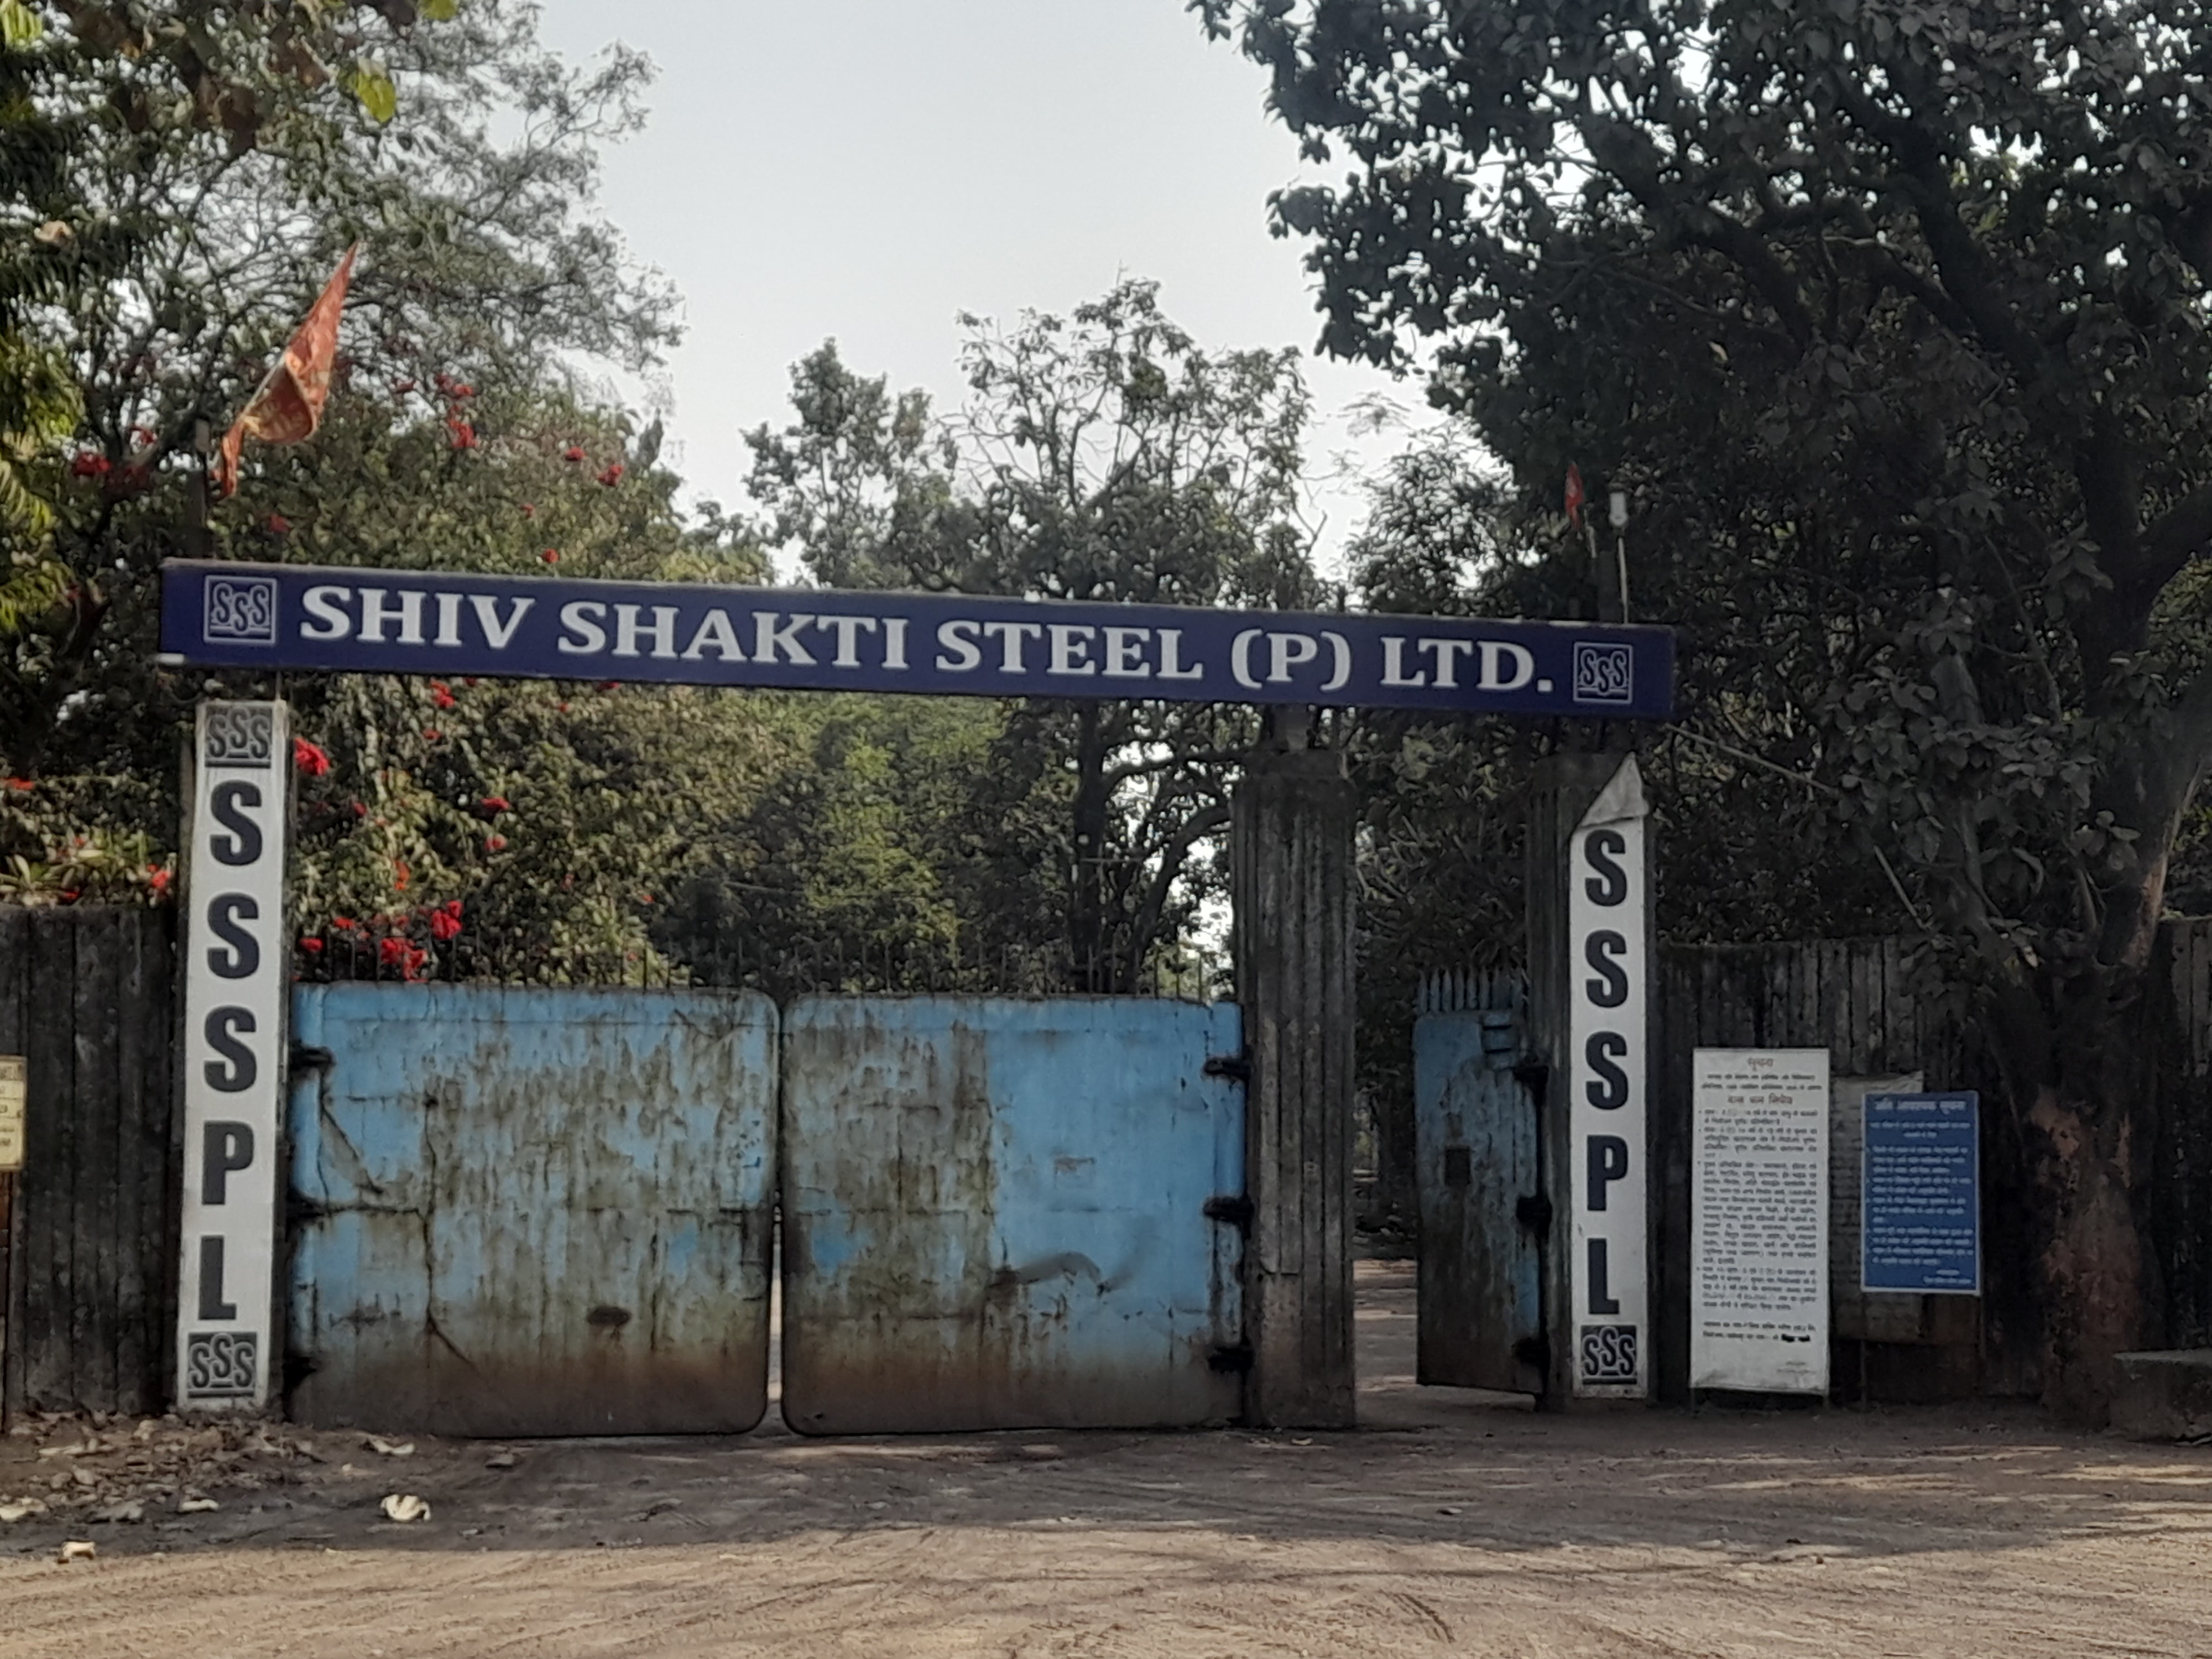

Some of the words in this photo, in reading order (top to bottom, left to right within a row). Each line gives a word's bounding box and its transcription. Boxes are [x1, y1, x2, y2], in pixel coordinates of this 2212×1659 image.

[300, 586, 535, 649] SHIV
[557, 601, 910, 669] SHAKTI
[936, 620, 1202, 679] STEEL
[1231, 629, 1352, 692] (P)
[1380, 637, 1553, 692] LTD.
